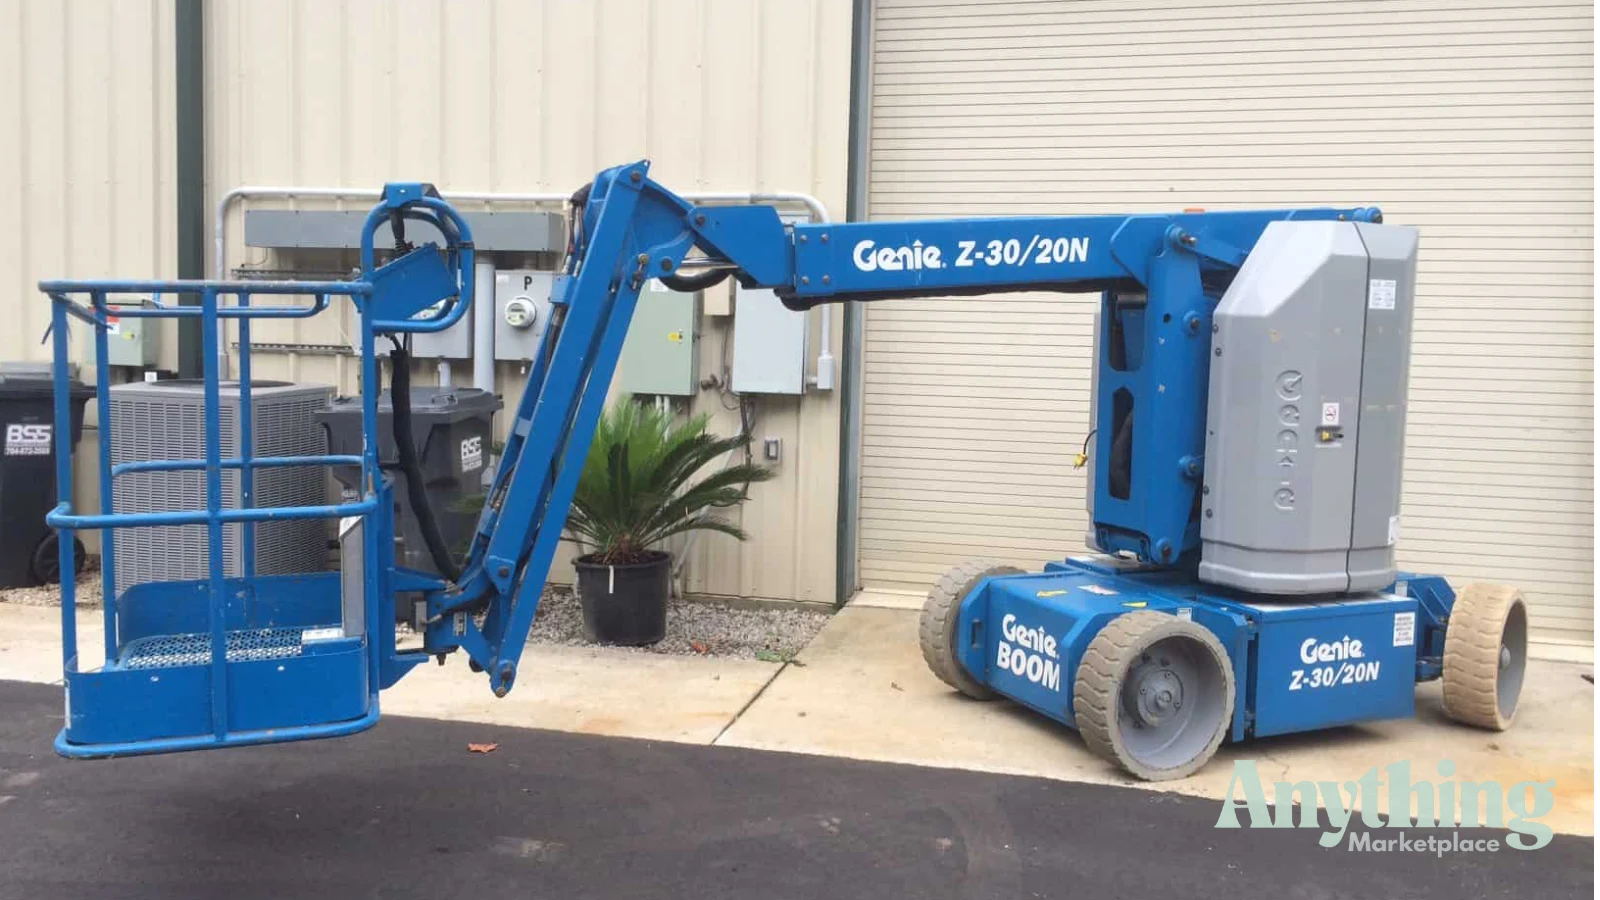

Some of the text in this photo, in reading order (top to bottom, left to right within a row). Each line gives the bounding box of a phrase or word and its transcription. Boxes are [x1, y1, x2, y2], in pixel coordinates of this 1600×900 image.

[853, 235, 1090, 272] Genie Z-30/20N
[523, 275, 533, 291] P
[6, 424, 51, 443] BSS
[1002, 613, 1058, 660] Genie
[1300, 634, 1365, 664] Genie
[997, 640, 1060, 692] BOOM
[1288, 661, 1380, 690] Z-30/20N
